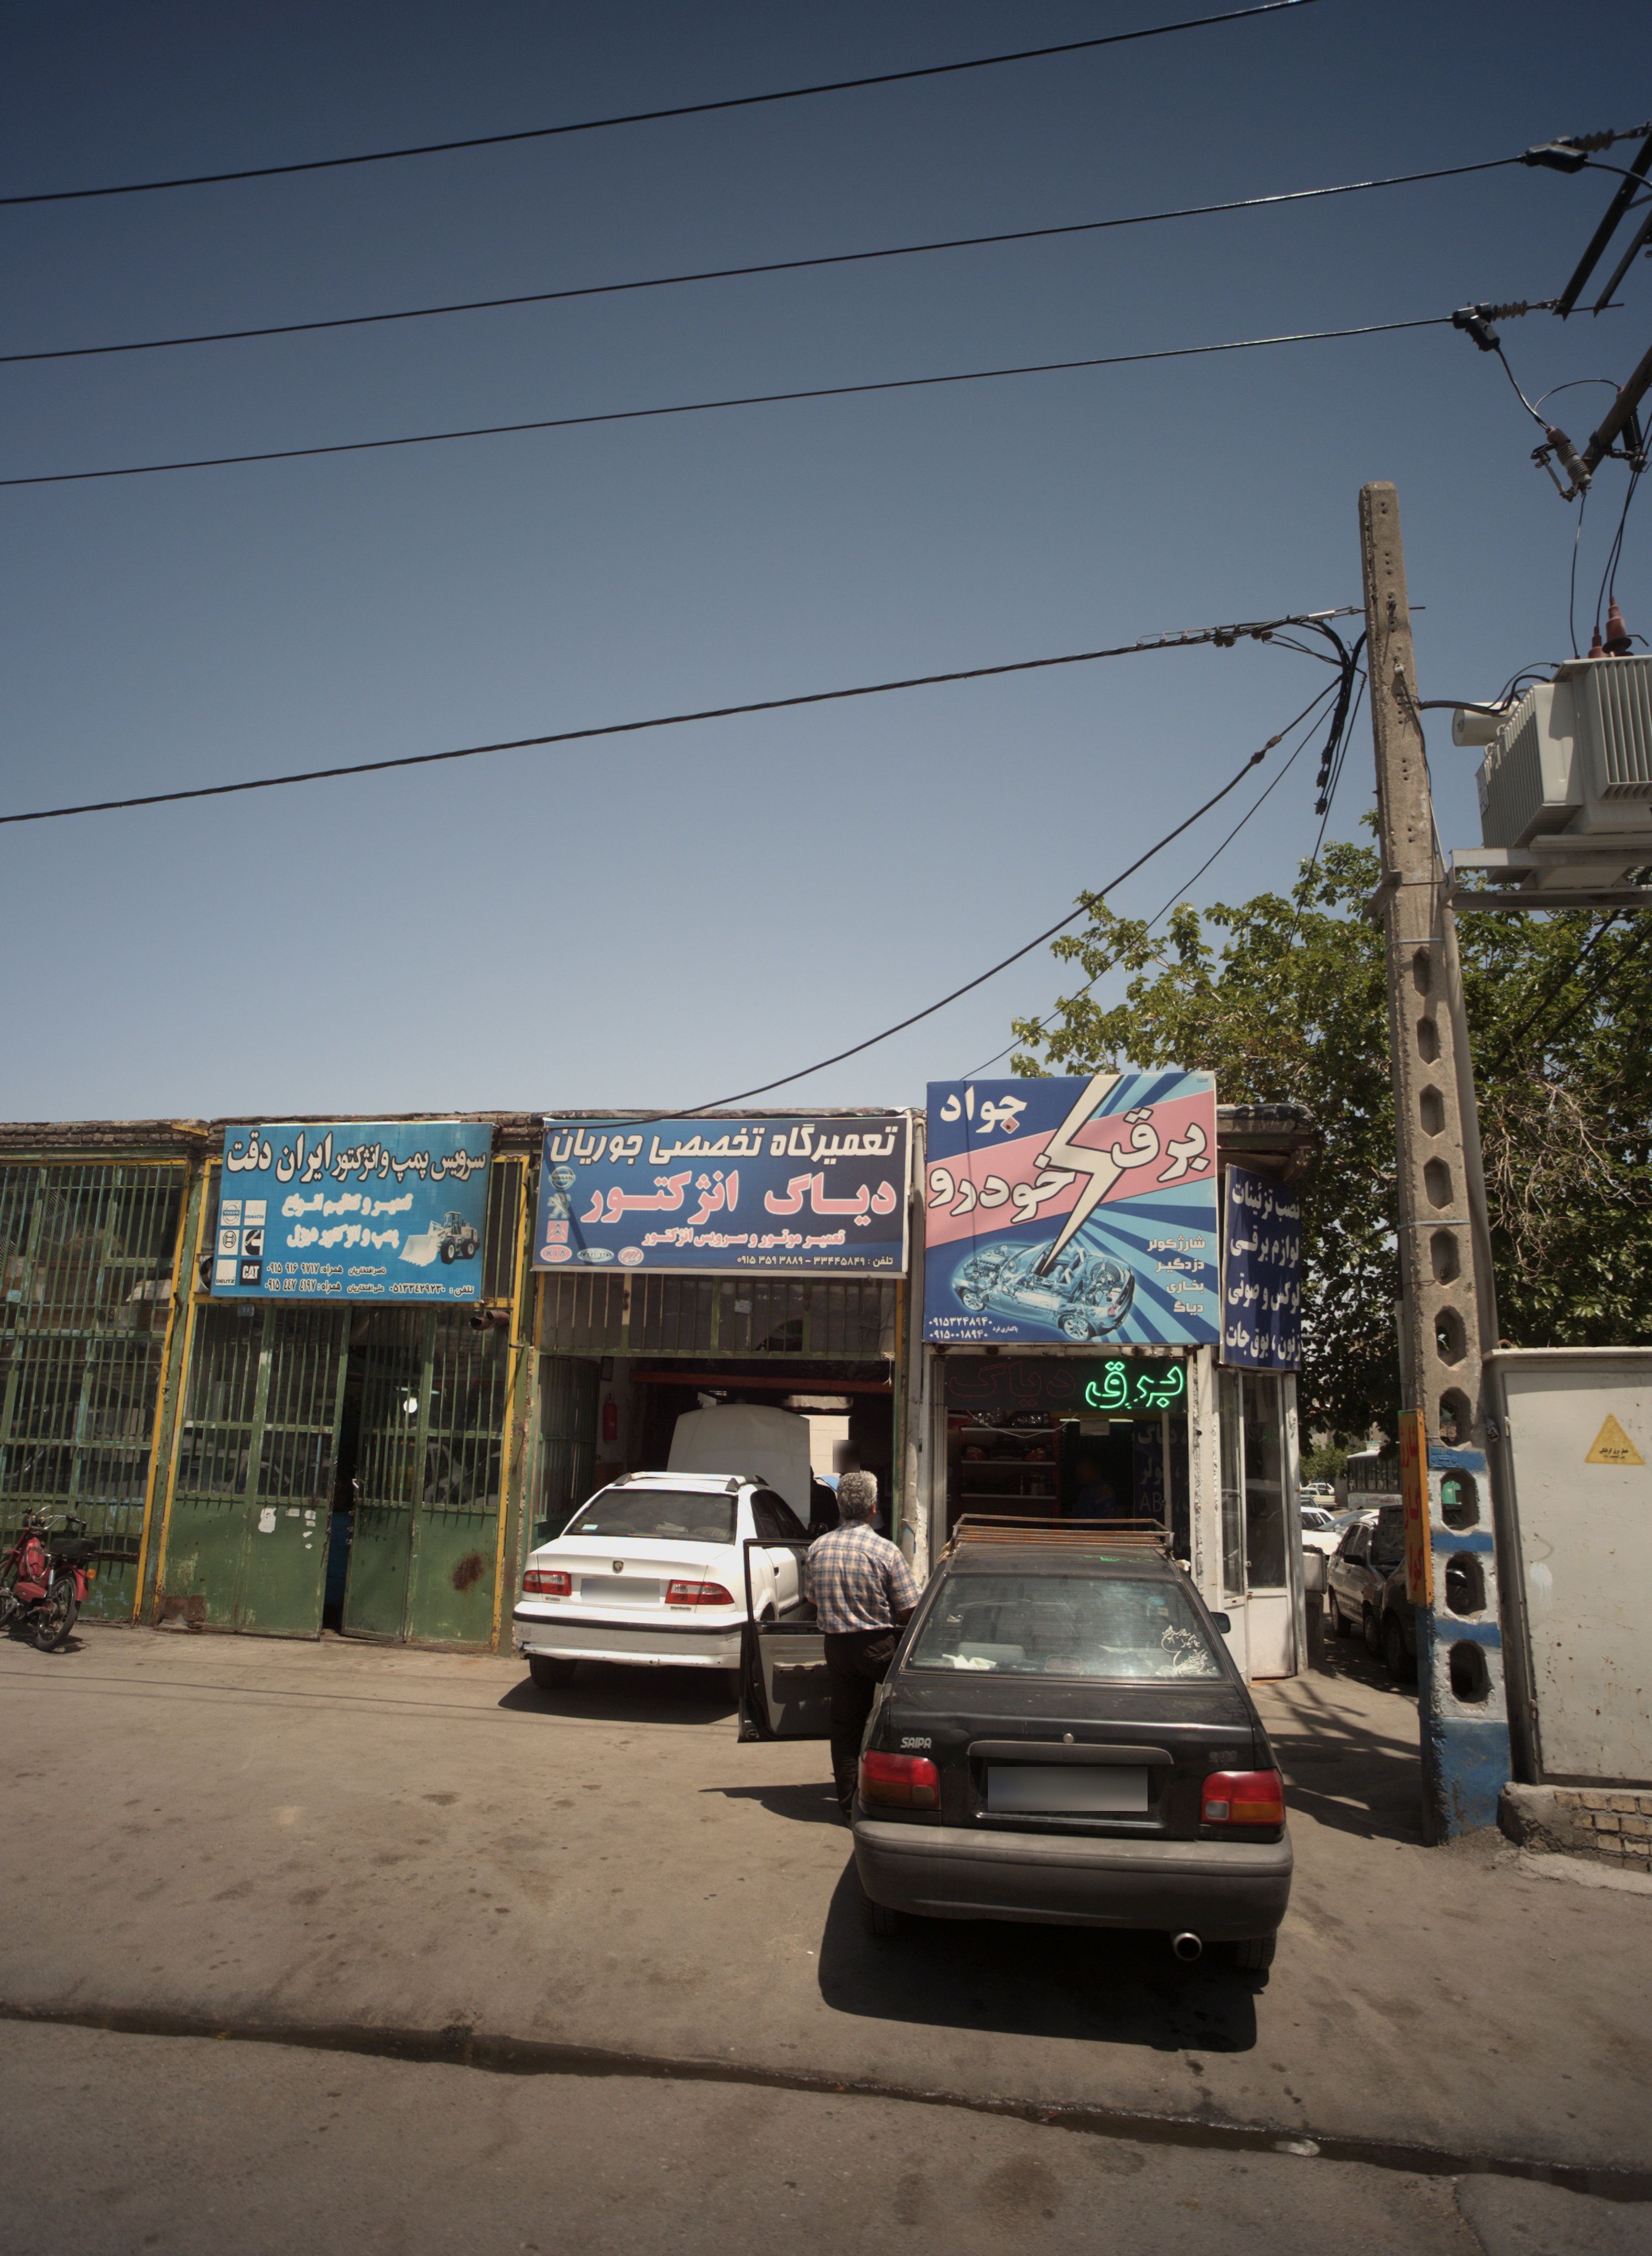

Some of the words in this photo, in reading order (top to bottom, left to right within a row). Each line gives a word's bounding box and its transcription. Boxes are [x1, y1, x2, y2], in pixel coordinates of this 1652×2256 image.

[939, 1084, 1028, 1134] جواد
[226, 1130, 273, 1172] دقت
[276, 1131, 333, 1183] ایران
[649, 1127, 767, 1165] تخصصی
[770, 1124, 899, 1165] تعمیرگاه
[1111, 1108, 1210, 1183] برق
[391, 1151, 429, 1183] پمپ
[431, 1149, 486, 1181] سرویس
[580, 1170, 739, 1224] انژکتور
[763, 1172, 897, 1226] دیاگ
[928, 1153, 1077, 1223] خودرو
[1232, 1181, 1273, 1220] تزئینات
[1275, 1197, 1300, 1222] نصب
[642, 1227, 694, 1247] انژکتور
[693, 1230, 747, 1248] سرویس
[748, 1233, 758, 1248] و
[758, 1229, 802, 1249] موتور
[802, 1229, 846, 1249] تعمیر
[1230, 1224, 1269, 1262] برقی
[1271, 1235, 1299, 1268] لوازم
[242, 1265, 259, 1279] CAT
[1155, 1257, 1205, 1273] دزدگیر
[1166, 1279, 1204, 1294] بخاری
[1228, 1272, 1259, 1308] صوتی
[1261, 1287, 1268, 1310] و
[1271, 1281, 1300, 1314] لوکس
[1173, 1300, 1204, 1315] دیاگ
[1226, 1321, 1250, 1356] جات
[1251, 1328, 1269, 1359] بوق
[1085, 1360, 1184, 1409] برق
[900, 1737, 932, 1749] SAIPA
